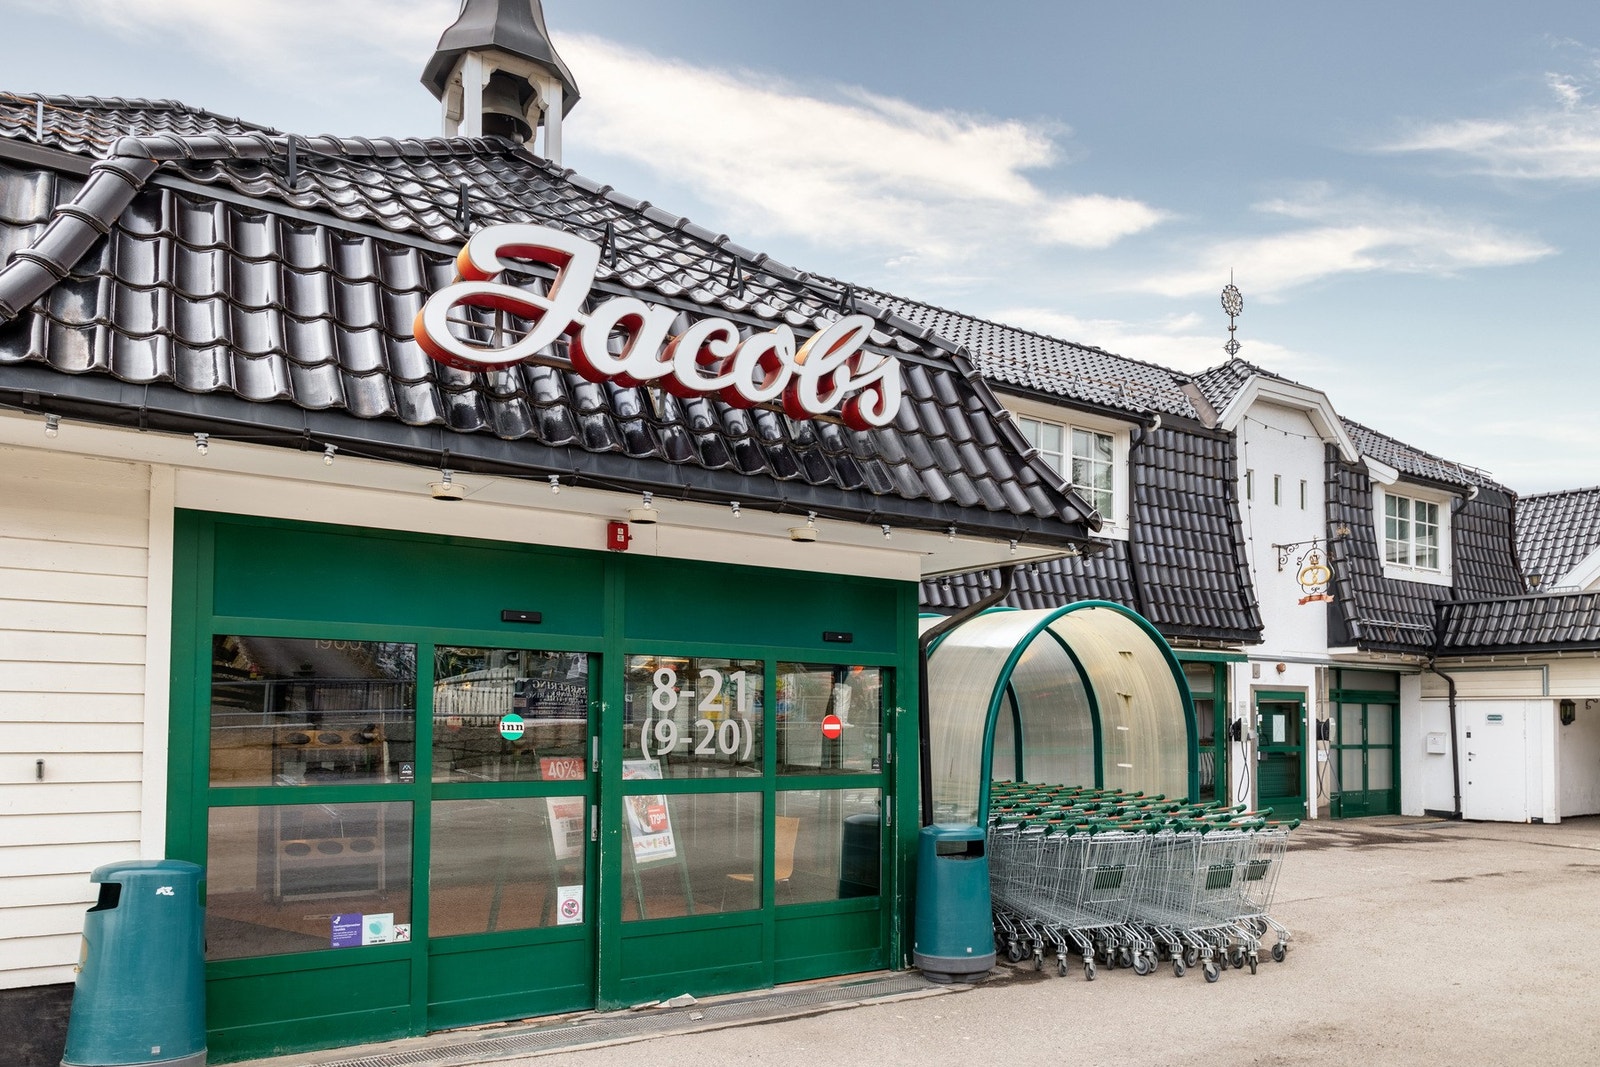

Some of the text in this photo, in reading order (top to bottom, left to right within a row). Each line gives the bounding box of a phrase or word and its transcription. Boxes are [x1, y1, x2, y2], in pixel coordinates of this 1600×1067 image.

[414, 223, 901, 429] Jacobs
[652, 667, 746, 712] 8-21
[501, 722, 524, 731] inn
[641, 717, 753, 762] (9-20)
[548, 760, 577, 778] 40%
